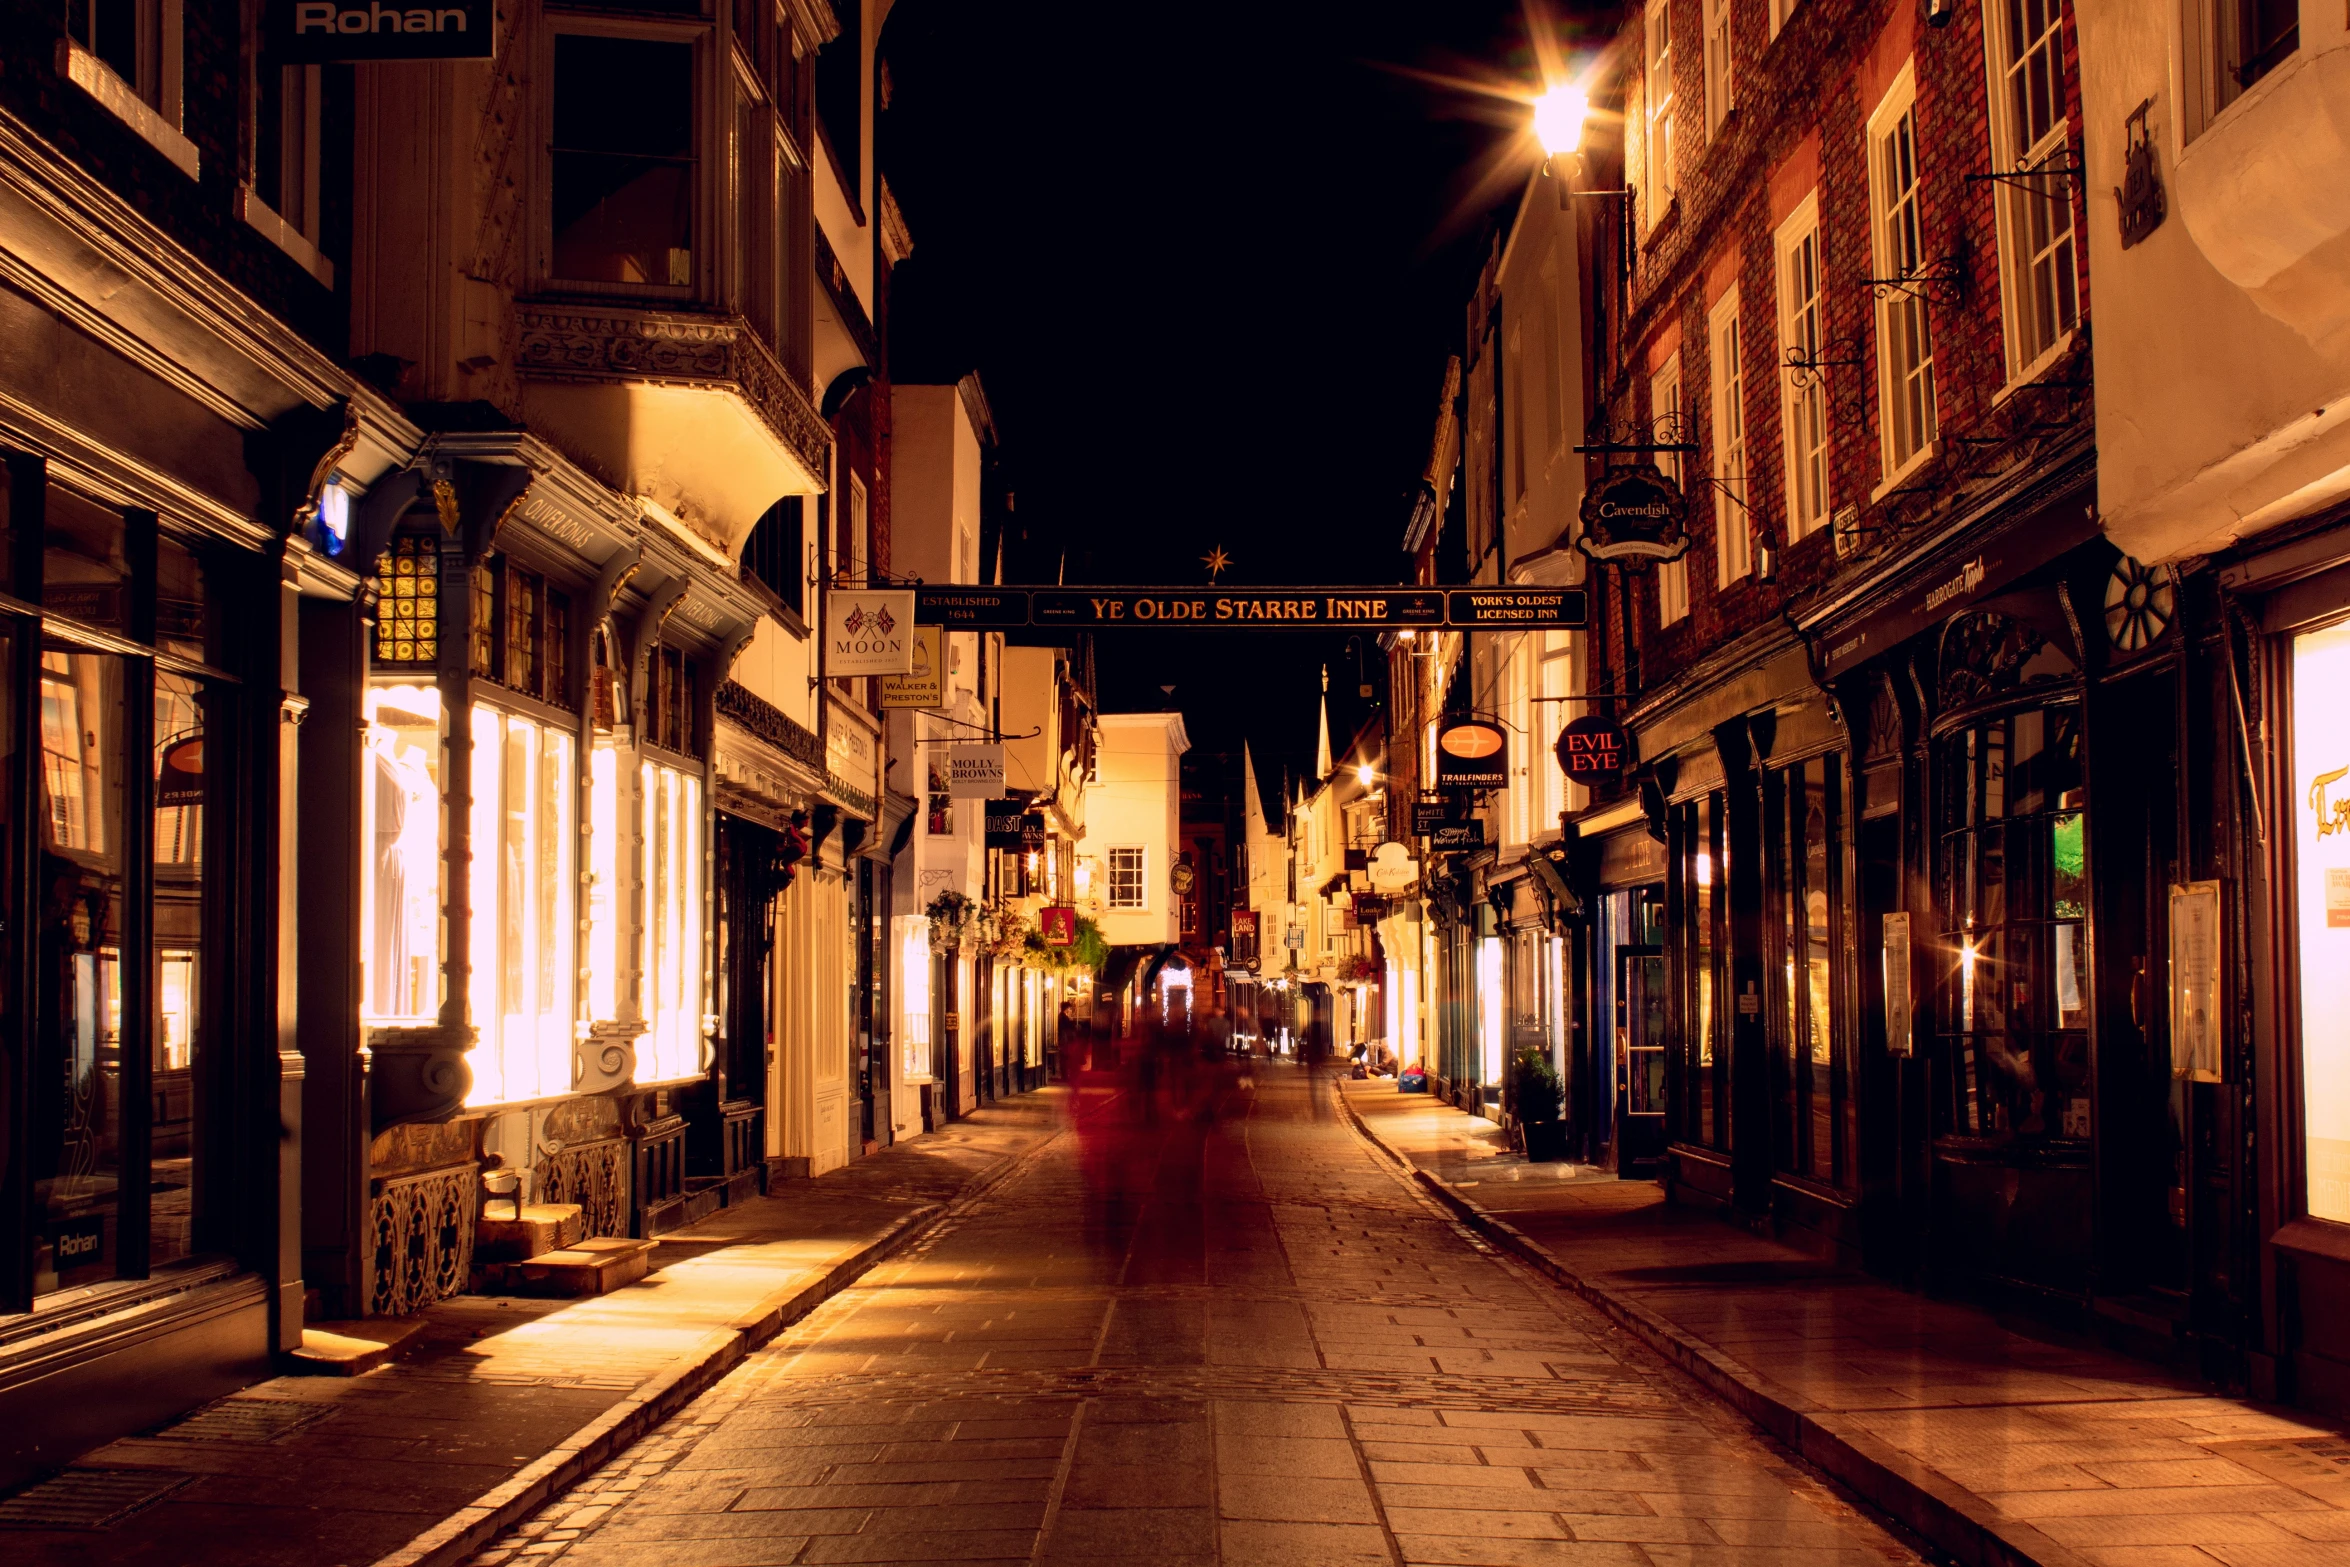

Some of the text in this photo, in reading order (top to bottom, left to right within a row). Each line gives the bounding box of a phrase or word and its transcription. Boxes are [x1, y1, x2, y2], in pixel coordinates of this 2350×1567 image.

[295, 1, 467, 35] Rohan
[1599, 501, 1670, 518] Cavendish
[524, 498, 595, 548] OLIVER BONAS
[1925, 573, 1964, 612] HARROGATE
[922, 596, 1001, 606] ESTABLISHED
[1471, 595, 1563, 606] YORK'S OLDEST
[1215, 598, 1317, 619] STARRE
[1325, 598, 1389, 619] INNE
[1476, 609, 1559, 619] LICENSED INN
[836, 640, 902, 653] MOON
[885, 682, 938, 690] WALKER &
[884, 693, 939, 702] PRESTON'S
[1567, 732, 1622, 752] EVIL
[952, 759, 994, 769] MOLLY
[1570, 752, 1620, 771] EYE
[952, 768, 1004, 778] BROWNS
[1441, 773, 1504, 781] TRAILFINDERS
[1417, 808, 1445, 817] WHITE
[1460, 830, 1481, 846] fish
[1360, 906, 1382, 914] Loake
[1234, 917, 1252, 925] LAKE
[1234, 924, 1255, 932] LAND
[59, 1233, 98, 1257] Rohan
